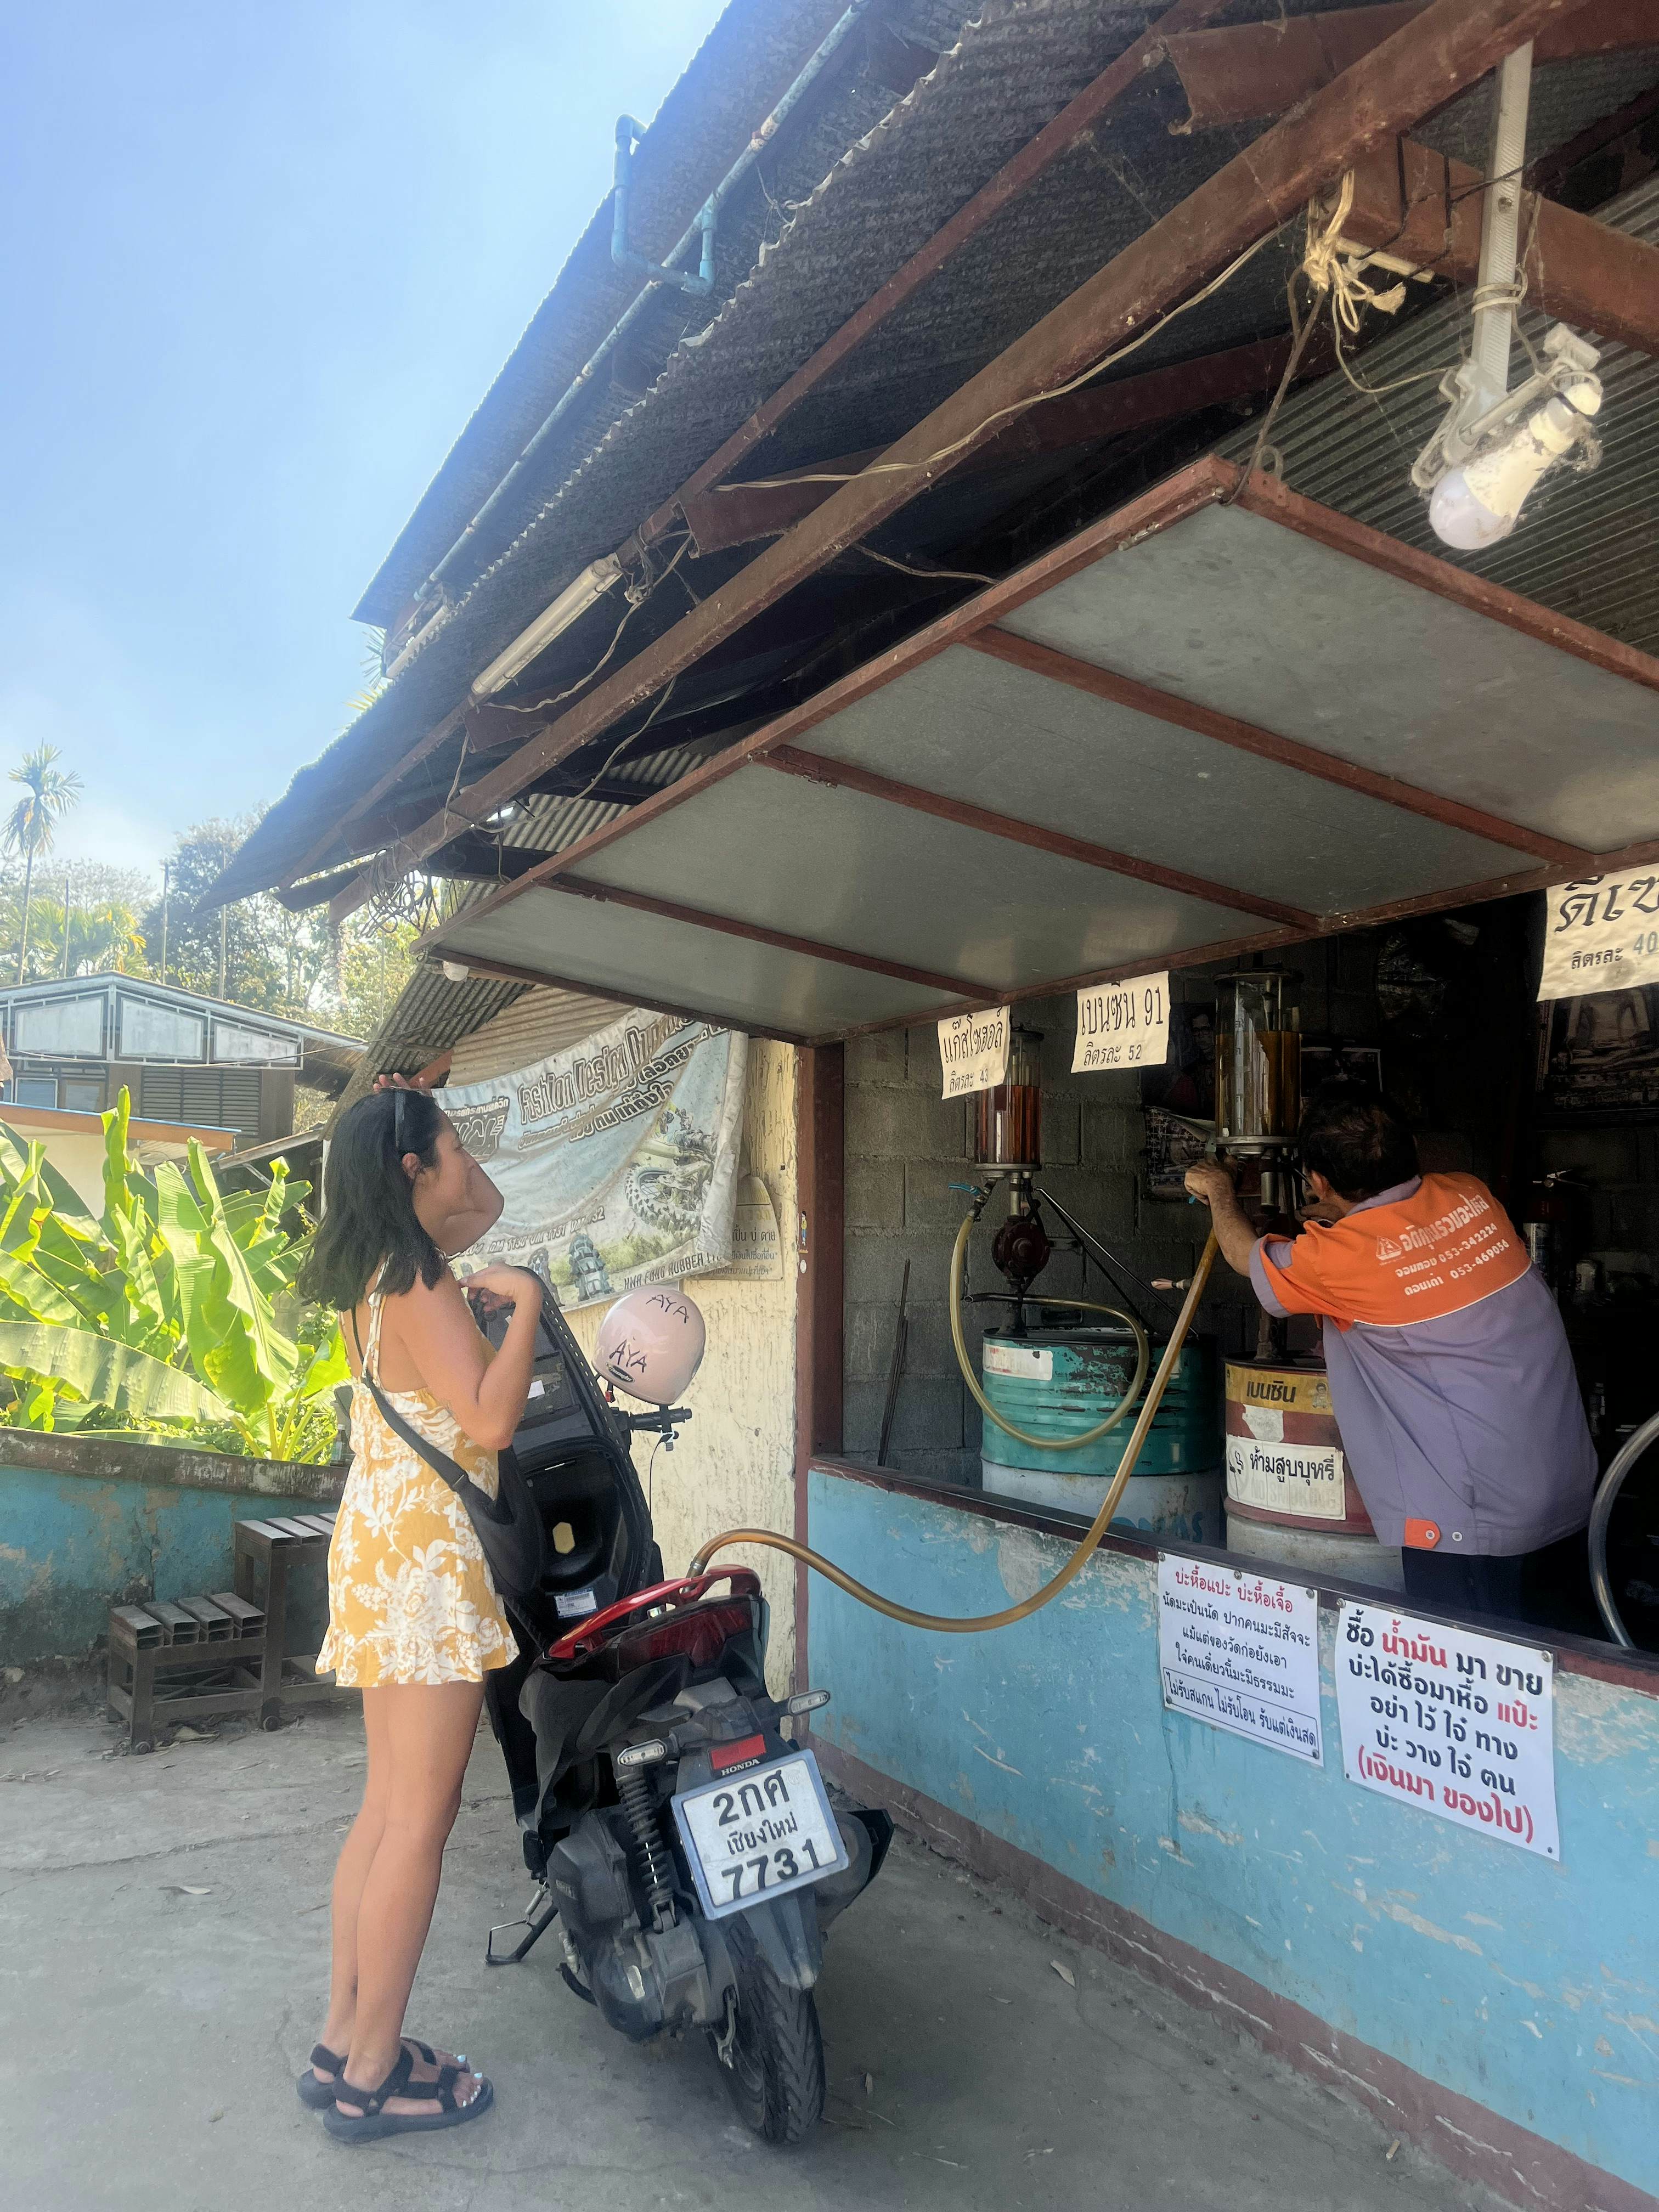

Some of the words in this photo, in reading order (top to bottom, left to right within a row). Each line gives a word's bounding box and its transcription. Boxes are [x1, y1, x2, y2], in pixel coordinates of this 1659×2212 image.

[1571, 950, 1623, 969] ลิตรละ
[1633, 932, 1658, 955] 40
[1145, 987, 1163, 1026] 91
[1084, 1042, 1121, 1066] ลิตรละ
[1128, 1045, 1142, 1060] 52
[950, 1071, 974, 1092] ลิตรละ
[980, 1068, 988, 1084] 43
[1395, 1257, 1437, 1277] จอมทอง
[1438, 1223, 1498, 1262] 053-342224
[624, 1274, 641, 1289] HWA
[668, 1253, 703, 1276] RUBBER
[646, 1294, 689, 1323] AYA
[609, 1339, 646, 1373] AYA
[1246, 1380, 1296, 1403] เบนซิน
[1250, 1446, 1335, 1486] ห้ามสูบบุหรี่
[1224, 1611, 1310, 1646] ปากคนมะมีสัจจะ
[1347, 1609, 1374, 1647] ซื้อ
[1383, 1620, 1448, 1668] น้ำมัน
[1456, 1652, 1486, 1680] มา
[1497, 1663, 1543, 1695] ขาย
[1349, 1653, 1488, 1714] บ่ะได้ซื้อมาหื้อ
[1166, 1671, 1214, 1709] ไม่รับสแกน
[1214, 1687, 1256, 1724] ไม่รับโอน
[1260, 1708, 1316, 1746] รับแต่เงินสด
[1370, 1695, 1408, 1723] อย่า
[1415, 1700, 1437, 1731] ไว้
[1476, 1730, 1518, 1759] ทาง
[1376, 1725, 1398, 1751] บ่ะ
[1406, 1740, 1441, 1767] วาง
[721, 1758, 760, 1776] HONDA
[713, 1770, 790, 1826] 2กศ
[1358, 1744, 1435, 1801] (เงินมา
[1444, 1786, 1533, 1843] ของไป)
[727, 1812, 798, 1855] เชียงใหม่
[721, 1838, 820, 1900] 7731
